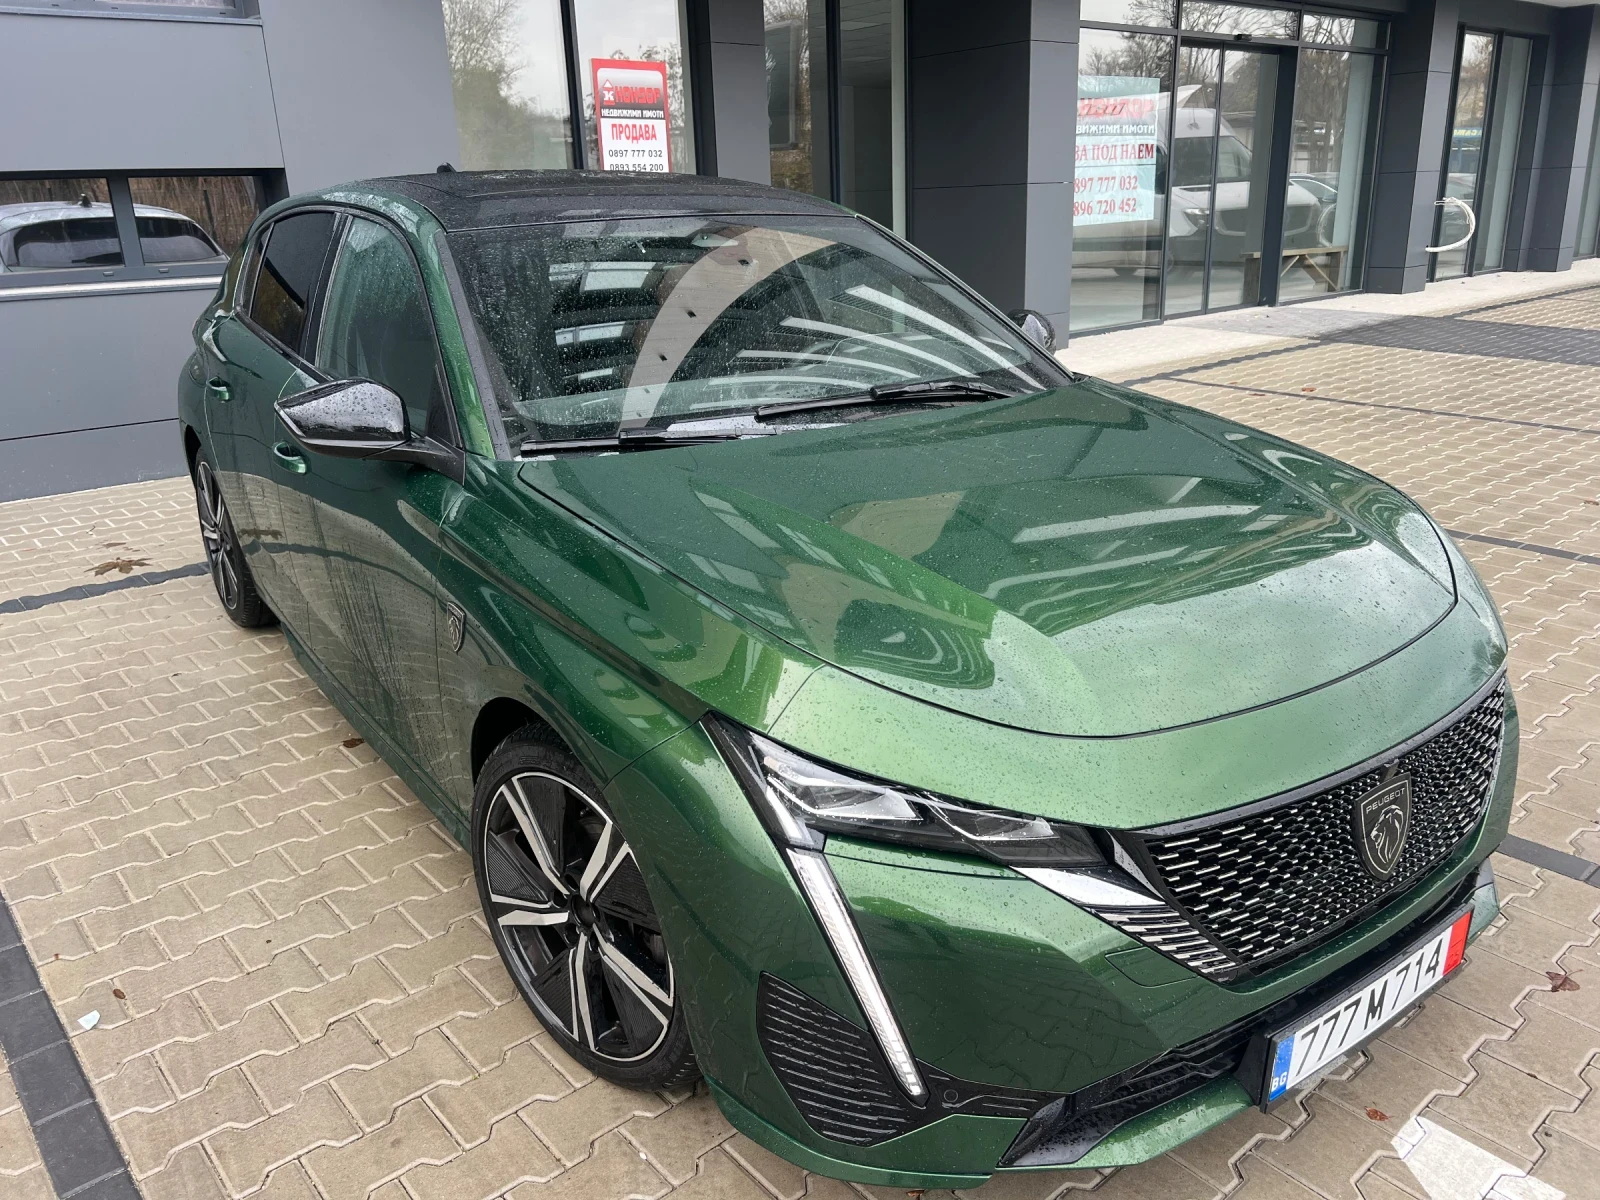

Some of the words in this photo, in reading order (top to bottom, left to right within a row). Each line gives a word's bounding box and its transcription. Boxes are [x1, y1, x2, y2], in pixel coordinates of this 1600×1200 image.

[601, 109, 642, 117] НЕДВИЖИМИ
[643, 110, 664, 118] ИМОТИ
[611, 123, 657, 144] ПРОДАВА
[1122, 124, 1155, 134] ИМОТИ
[608, 149, 629, 158] 0897
[631, 149, 646, 158] 777
[648, 149, 663, 158] 032
[1092, 144, 1118, 163] ПОД
[1120, 143, 1155, 160] НАЕМ
[609, 163, 630, 172] 0893
[632, 163, 647, 172] 554
[649, 163, 664, 172] 200
[1097, 176, 1117, 193] 777
[1119, 175, 1138, 191] 032
[1096, 199, 1116, 215] 720
[1118, 197, 1137, 213] 452
[1365, 787, 1405, 815] PEUGEOT
[1271, 1071, 1288, 1092] BG
[1296, 996, 1363, 1077] 777
[1363, 978, 1389, 1031] M
[1391, 937, 1444, 1011] 714
